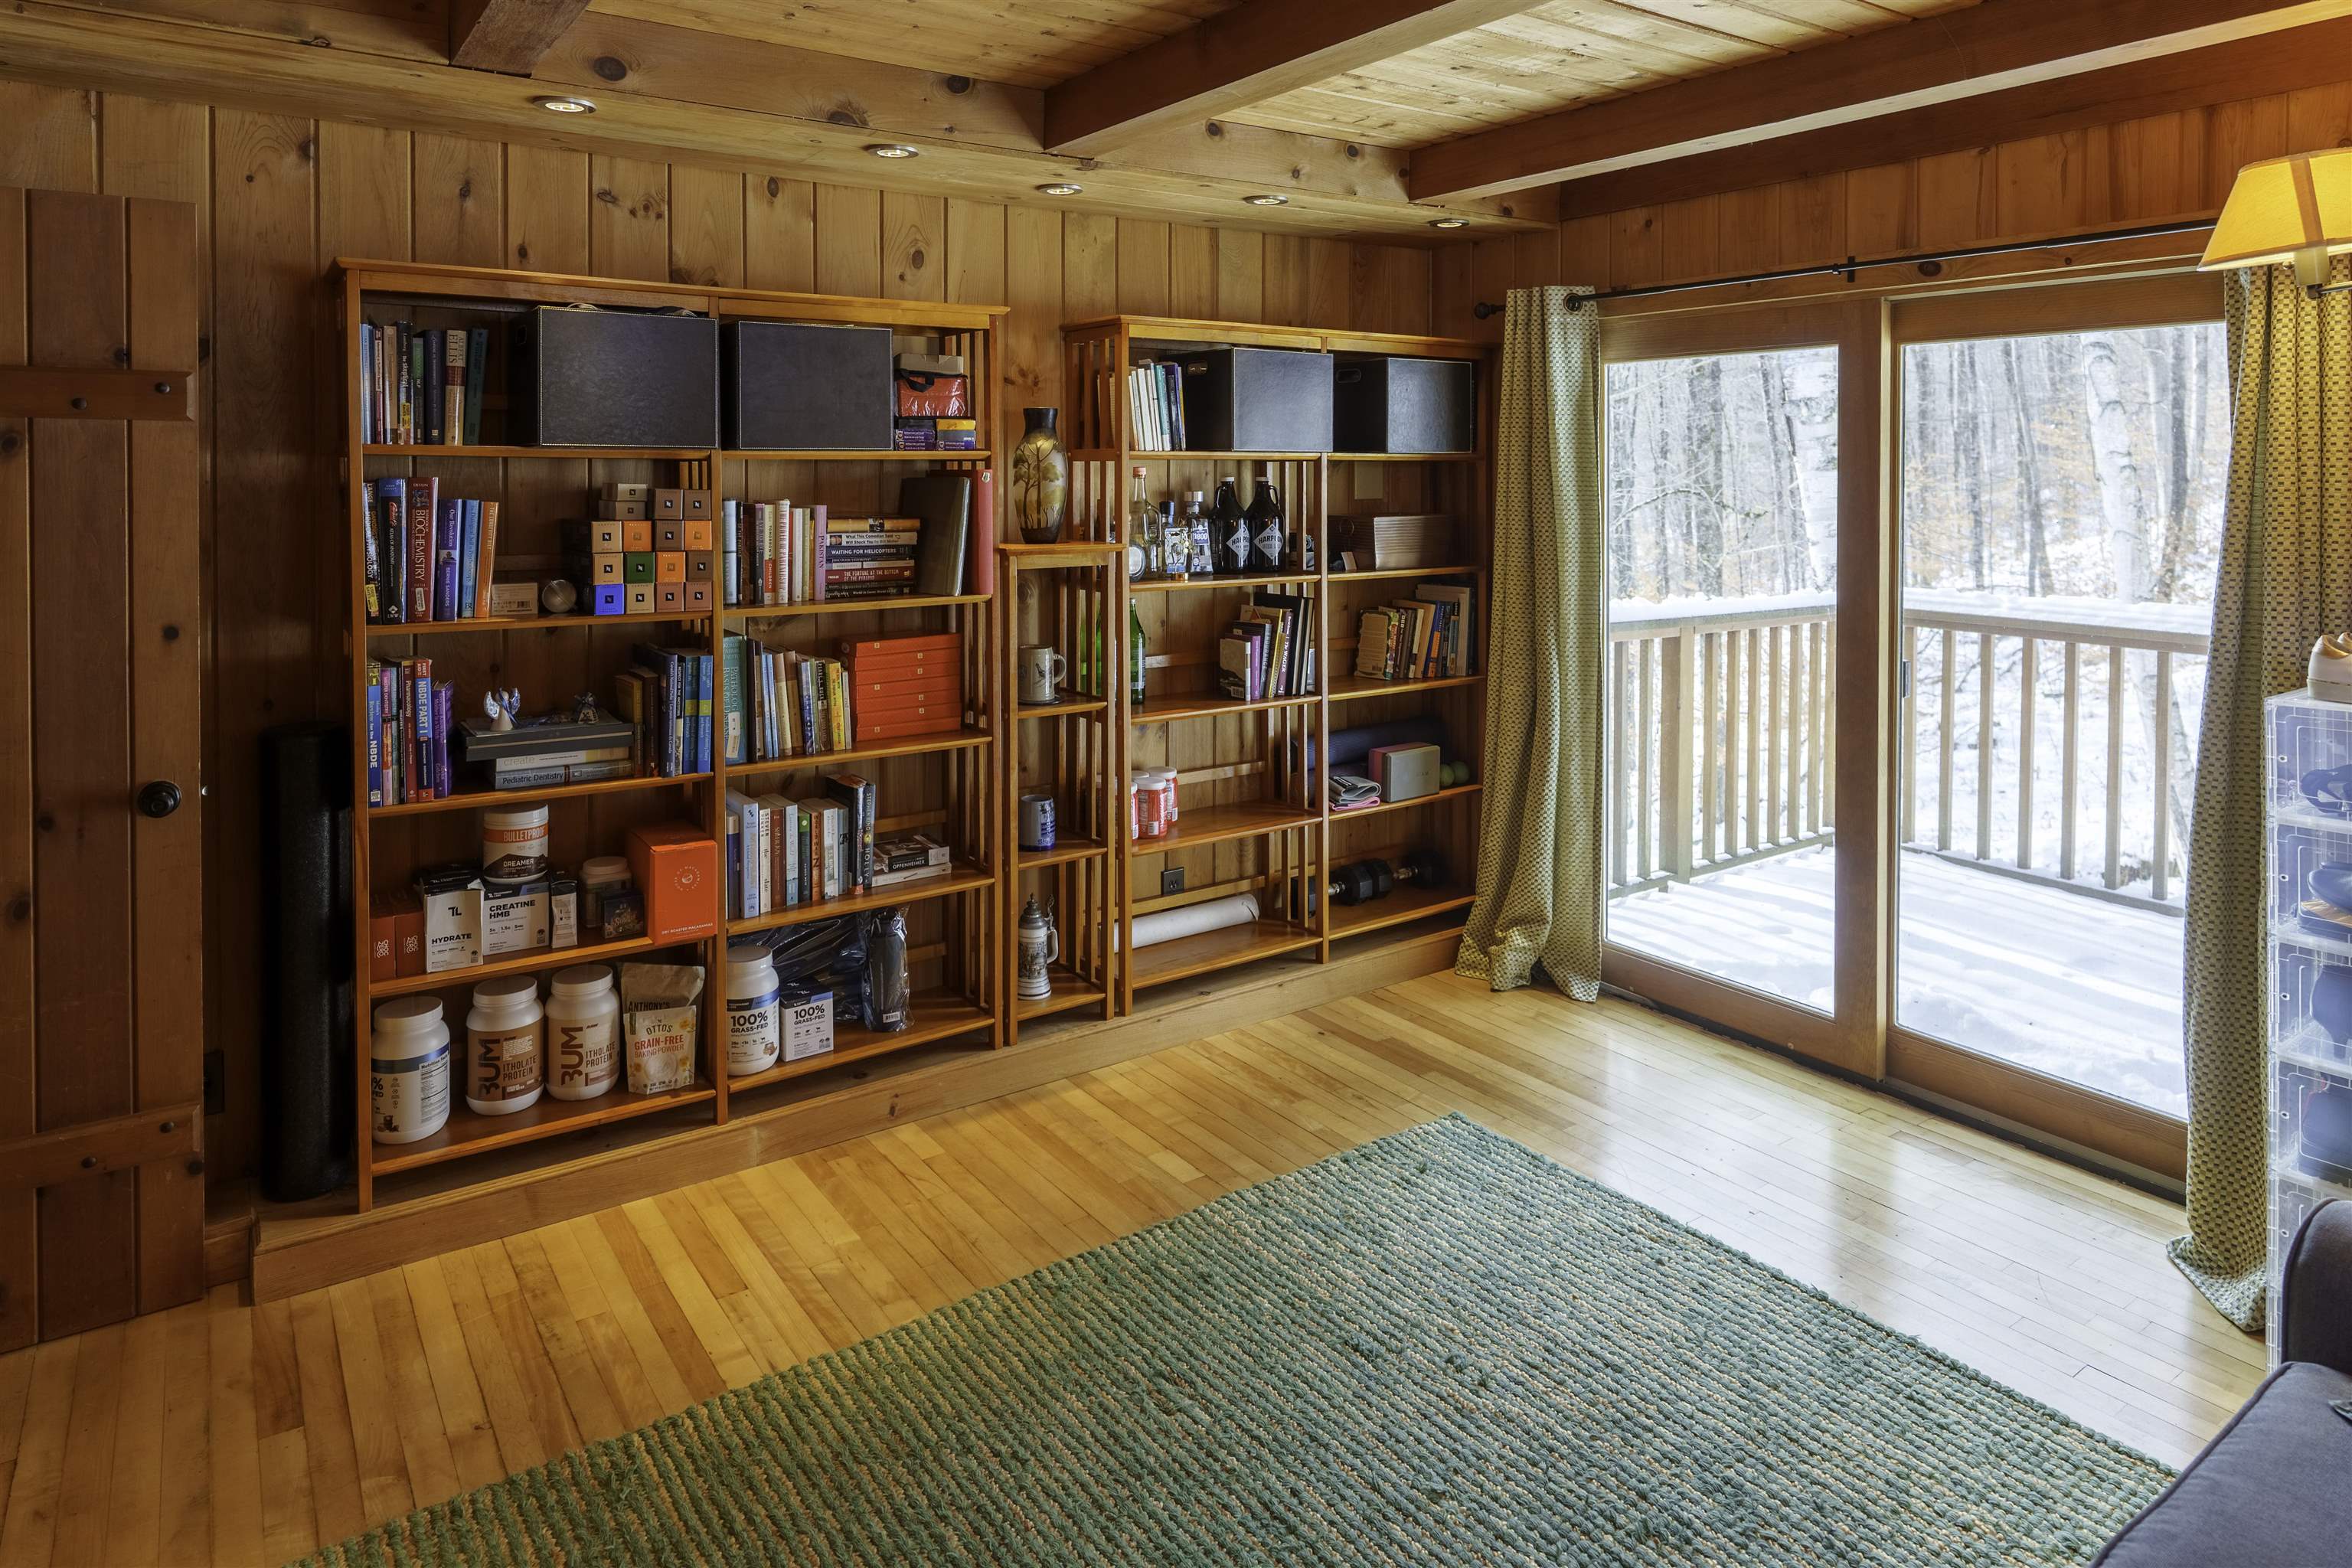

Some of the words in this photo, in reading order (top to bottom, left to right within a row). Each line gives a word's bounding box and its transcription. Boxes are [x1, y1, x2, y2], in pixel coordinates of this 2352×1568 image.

[449, 335, 458, 363] ELLIS
[415, 509, 426, 580] BIOCHEMISTRY
[418, 681, 427, 706] NBDE
[419, 707, 428, 727] PART
[503, 756, 534, 766] create
[502, 776, 531, 785] Pediatric
[534, 772, 564, 783] Dentistry
[503, 826, 545, 842] BULLETPROOF
[503, 858, 534, 867] CREAMER
[893, 860, 925, 869] OPPENHEIMER
[489, 900, 535, 912] CREATINE
[489, 911, 510, 920] HMB
[432, 933, 472, 945] HYDRATE
[628, 1001, 670, 1012] ANTHONY'S
[794, 1004, 825, 1019] 100%
[730, 1011, 768, 1027] 100%
[794, 1014, 825, 1025] GRASS-FED
[646, 1023, 673, 1035] OTTO'S
[730, 1022, 768, 1034] GRASS-FED
[586, 1041, 616, 1057] ITHOLATE
[634, 1034, 684, 1050] GRAIN-FREE
[635, 1047, 657, 1059] BAKING
[658, 1044, 684, 1054] POWDER
[421, 1059, 439, 1070] Nutrition
[586, 1052, 612, 1068] PROTEIN
[503, 1065, 534, 1081] PROTEIN
